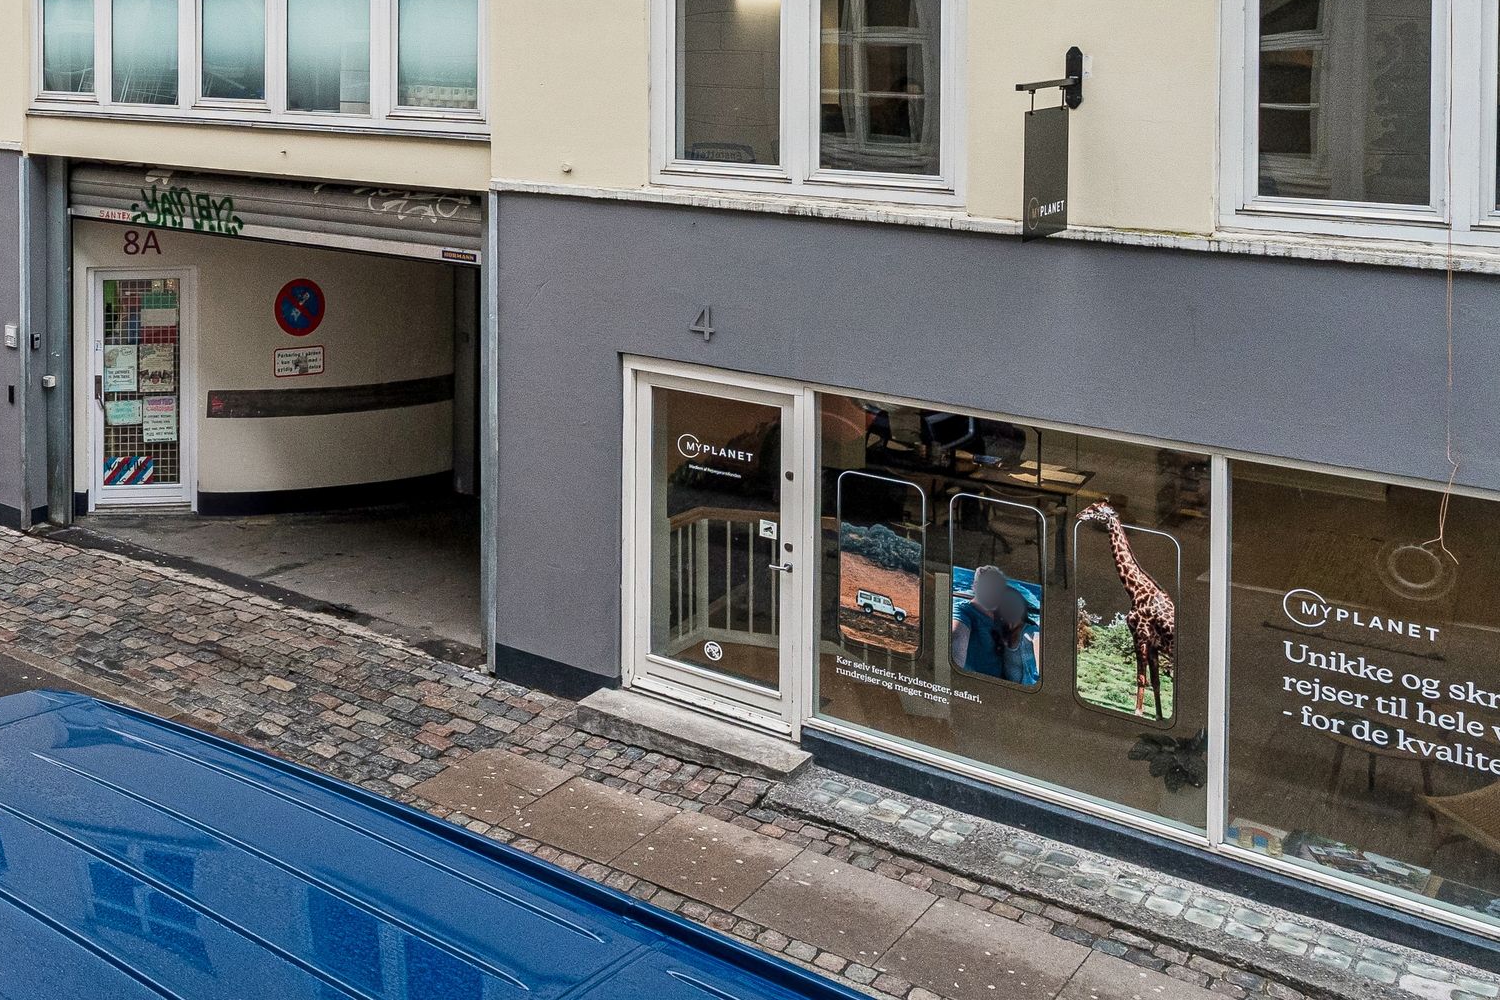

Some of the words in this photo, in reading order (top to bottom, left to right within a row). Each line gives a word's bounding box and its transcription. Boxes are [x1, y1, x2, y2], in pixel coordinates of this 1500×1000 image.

[100, 210, 132, 221] SANTEX
[123, 230, 162, 255] 8A
[690, 304, 716, 341] 4
[686, 441, 753, 462] MYPLANET
[1301, 600, 1440, 642] MYPLANET
[836, 655, 852, 667] Kør
[853, 660, 871, 672] selv
[871, 663, 897, 680] ferier,
[898, 672, 952, 696] krydstogter,
[953, 689, 982, 704] safari,
[836, 667, 881, 685] rundrejser
[882, 680, 893, 690] og
[894, 683, 923, 697] meget
[924, 691, 950, 705] mere.
[1283, 640, 1393, 684] Unikke
[1402, 673, 1441, 699] og
[1283, 676, 1369, 709] rejser
[1376, 696, 1408, 720] til
[1416, 702, 1484, 737] hele
[1301, 705, 1345, 734] for
[1351, 720, 1389, 745] de
